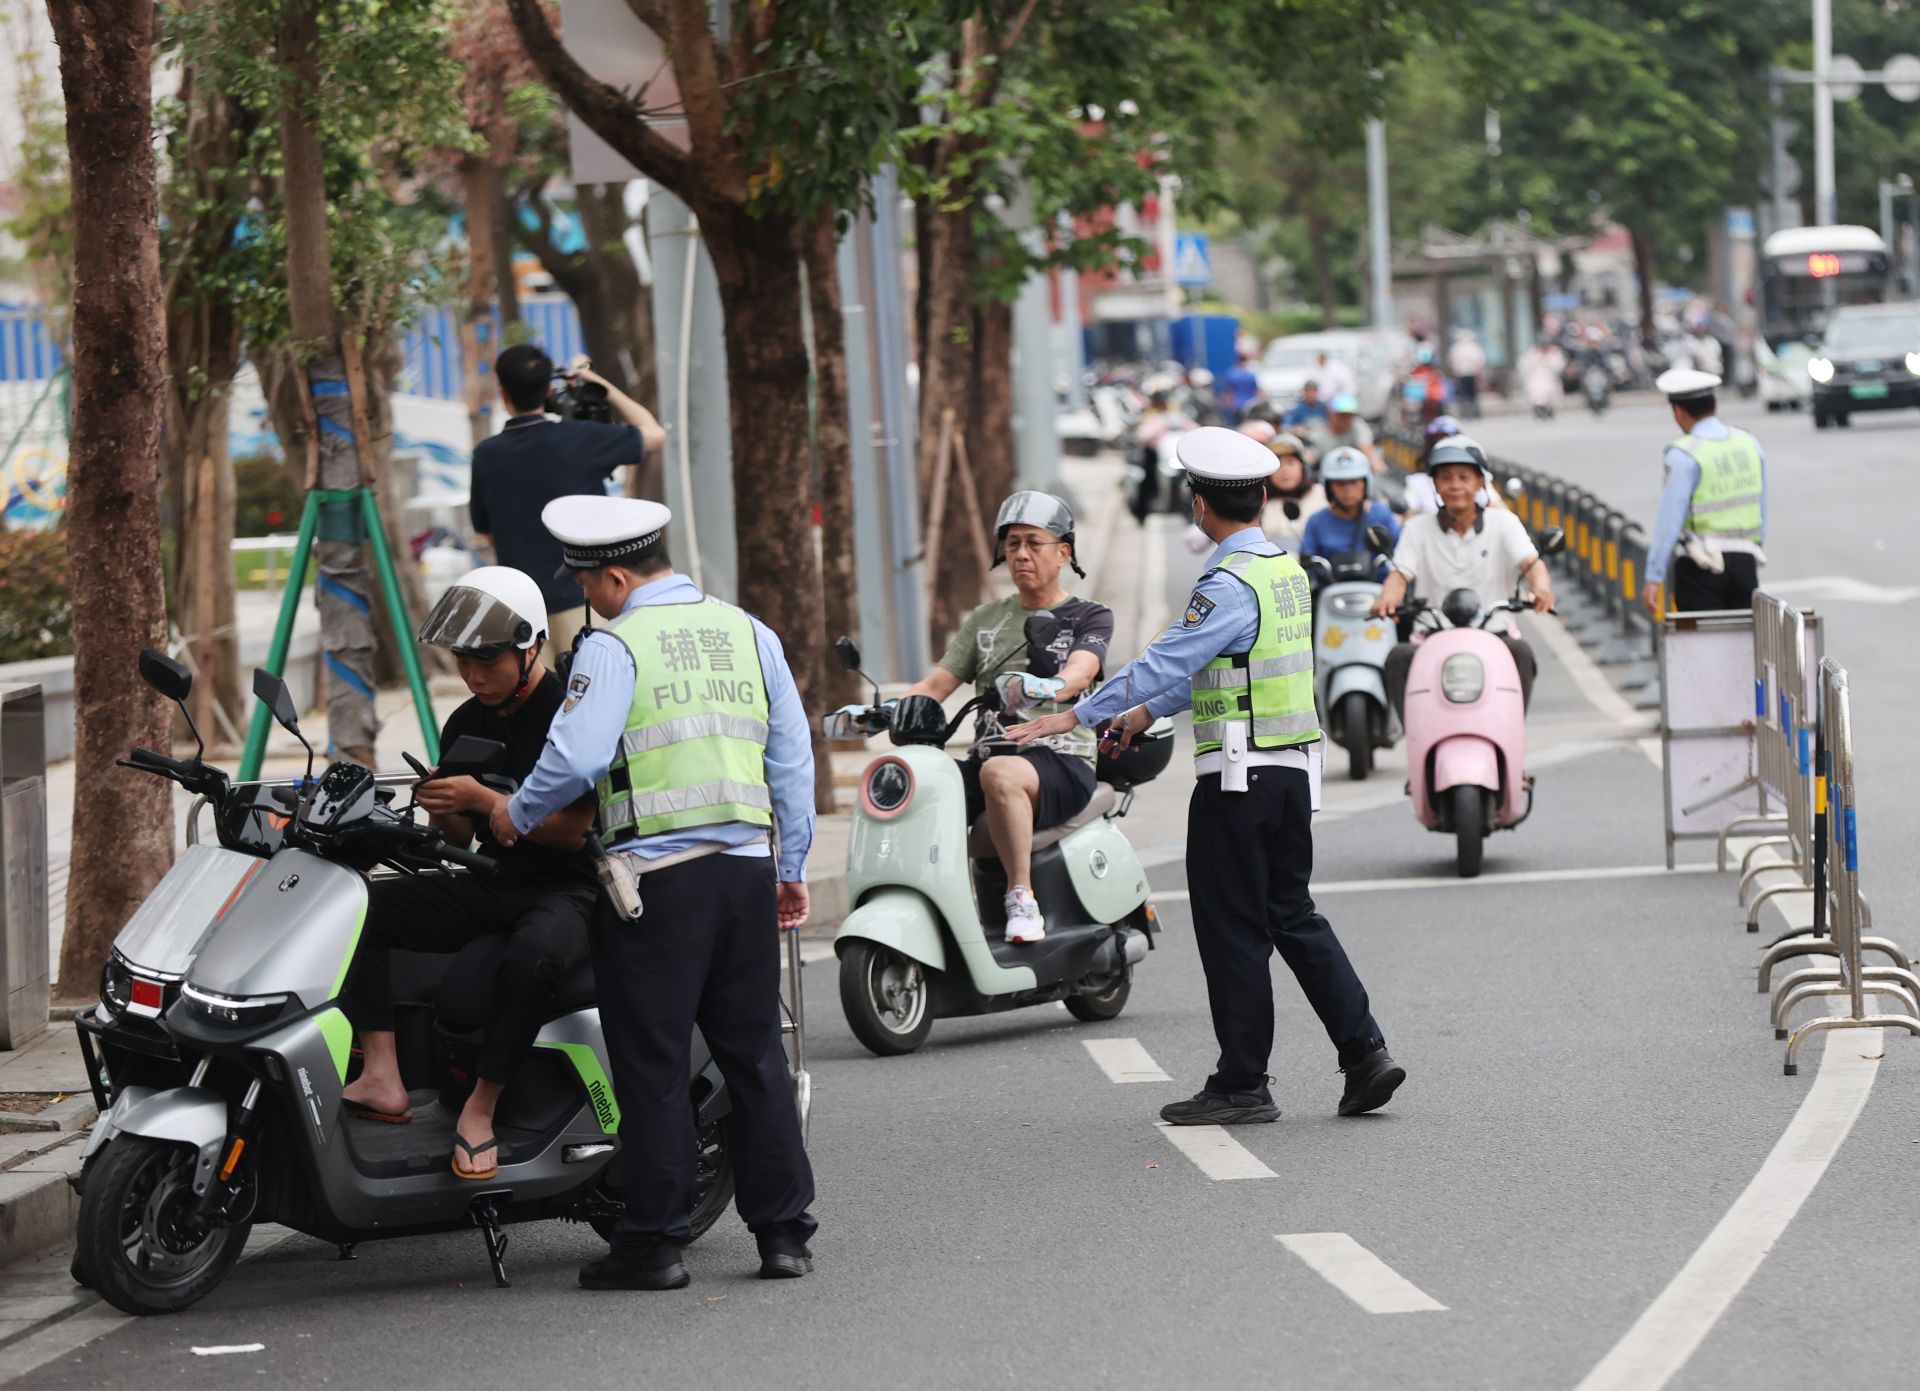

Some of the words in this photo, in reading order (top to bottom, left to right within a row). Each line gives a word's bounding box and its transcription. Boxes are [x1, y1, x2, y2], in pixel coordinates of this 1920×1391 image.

[656, 627, 735, 673] 辅警
[653, 680, 692, 710] FU
[698, 678, 754, 704] JING
[588, 1080, 616, 1129] ninebot
